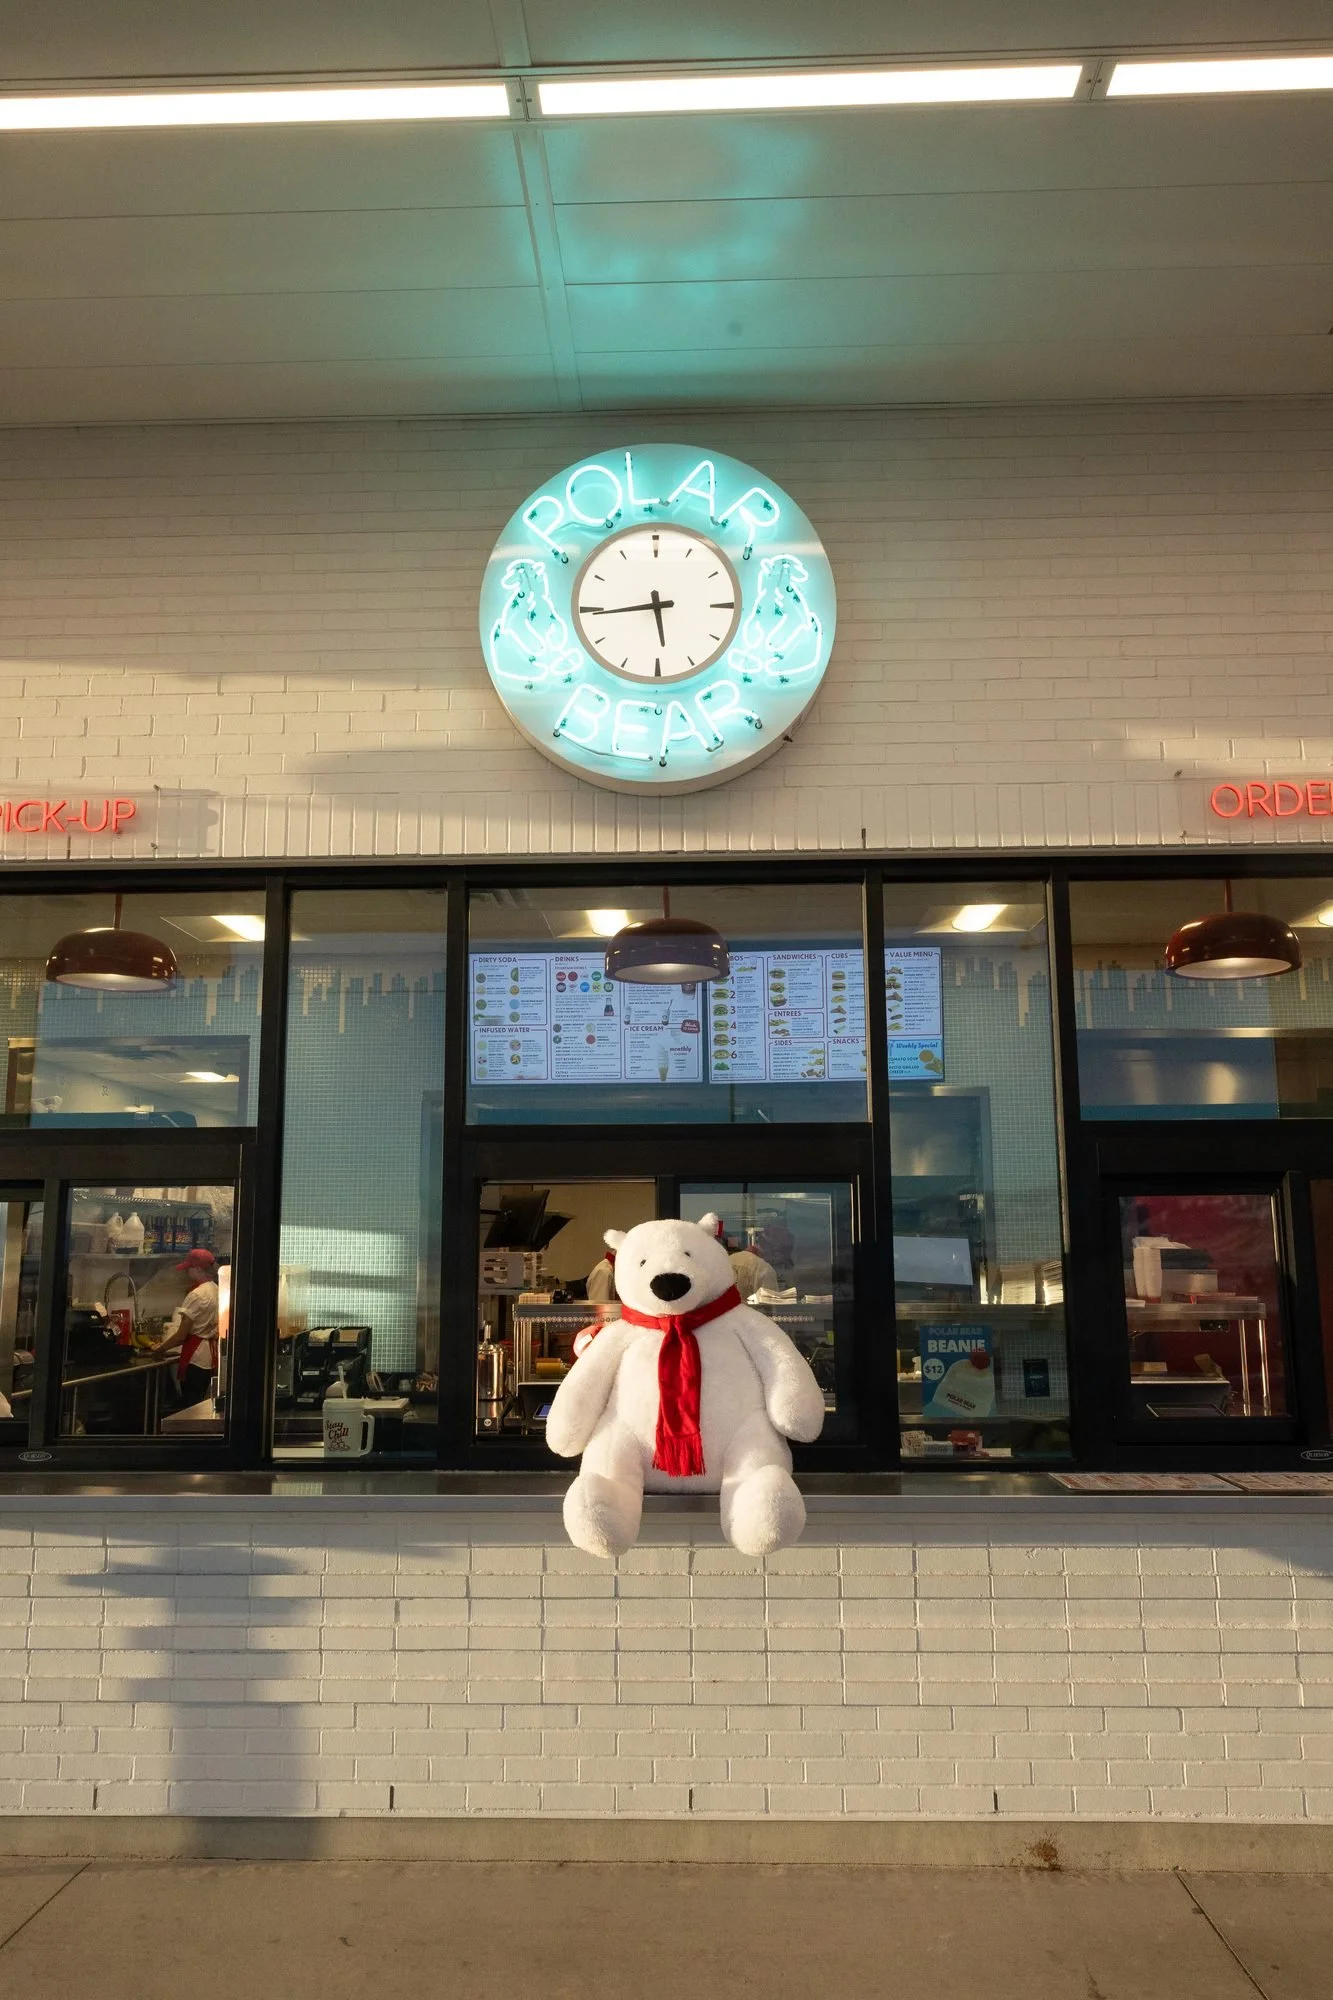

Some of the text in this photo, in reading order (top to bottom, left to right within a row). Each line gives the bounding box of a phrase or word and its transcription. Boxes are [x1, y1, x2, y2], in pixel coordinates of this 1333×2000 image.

[523, 452, 780, 562] POLAR
[554, 681, 763, 766] BEAR
[1211, 781, 1333, 818] ORDE
[0, 797, 136, 833] ICK-UP
[731, 976, 735, 984] 1
[730, 991, 736, 999] 2
[730, 1006, 736, 1014] 3
[731, 1037, 737, 1045] 5
[731, 1051, 737, 1059] 6
[927, 1339, 985, 1353] BEANIE
[925, 1365, 944, 1374] $12
